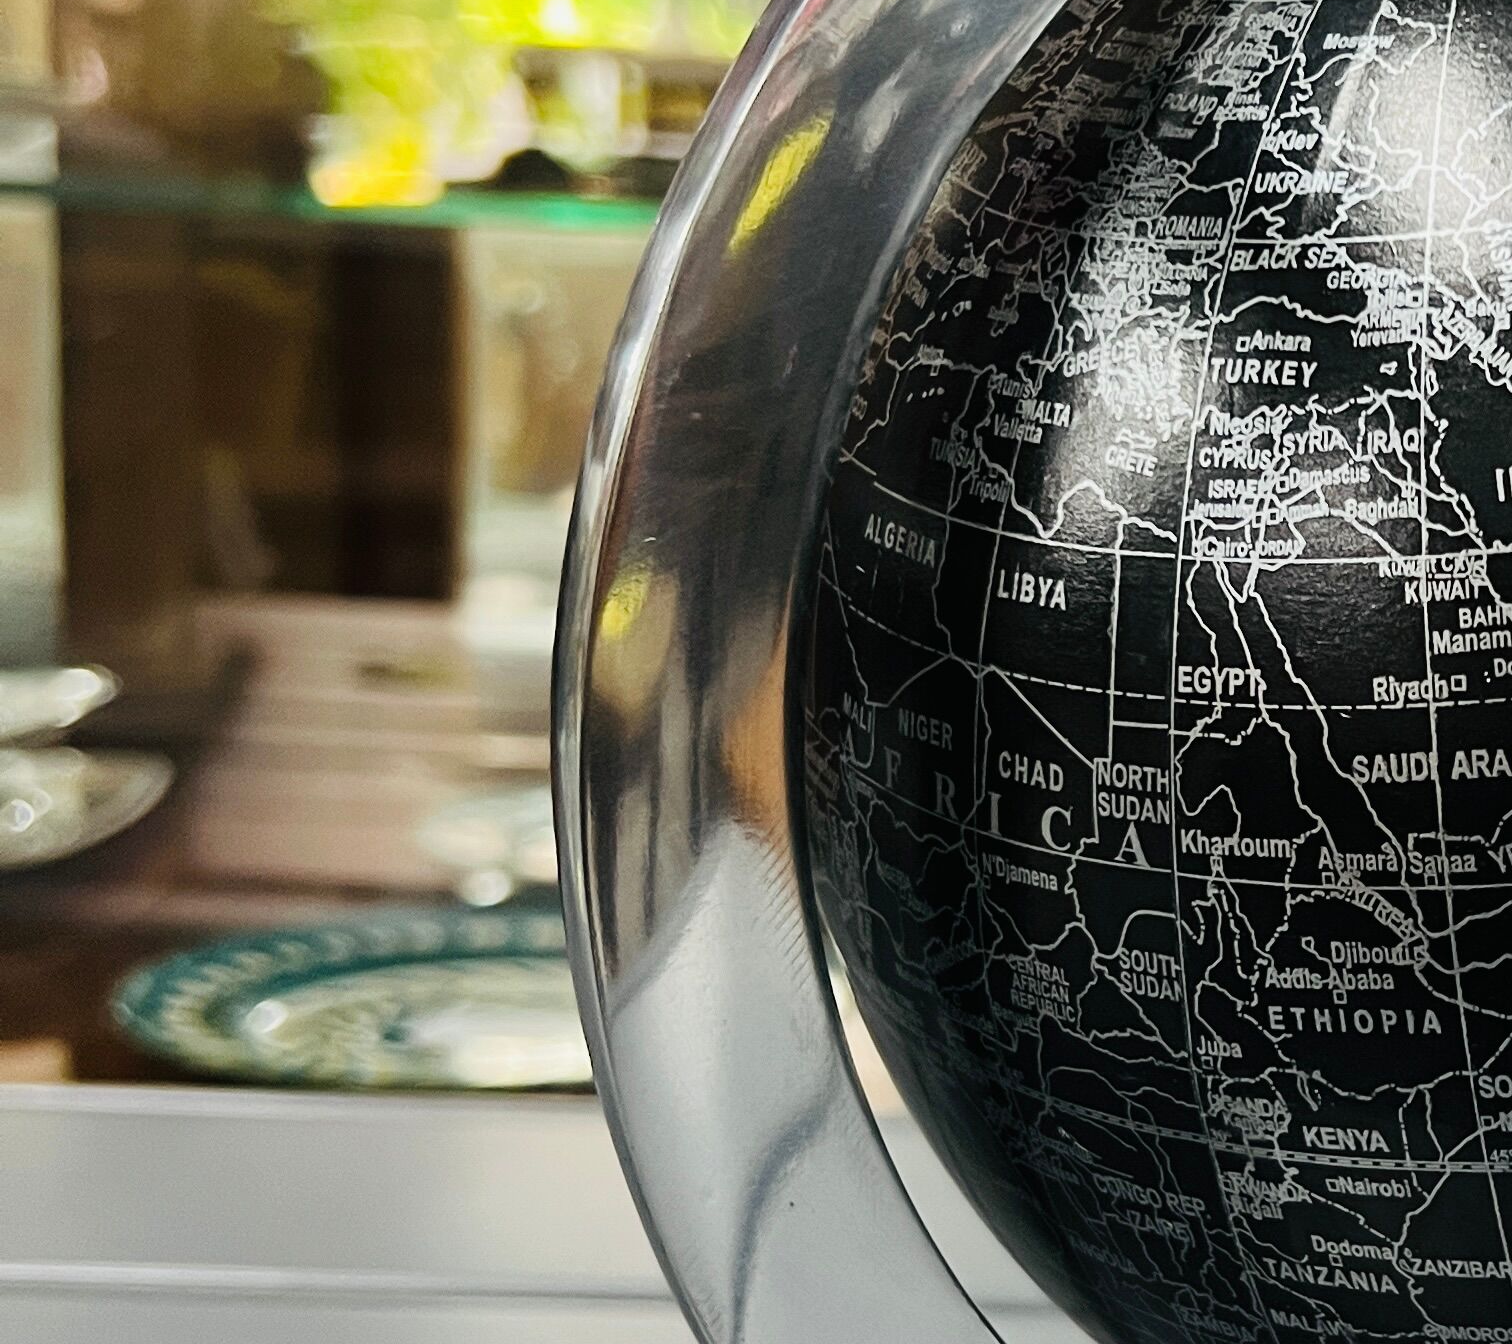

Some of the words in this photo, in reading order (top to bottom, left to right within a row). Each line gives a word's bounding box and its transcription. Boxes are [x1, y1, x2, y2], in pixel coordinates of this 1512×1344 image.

[1323, 33, 1396, 51] Moscow
[1255, 171, 1349, 194] UKRAINE
[1155, 215, 1223, 238] ROMANIA
[1230, 247, 1298, 272] BLACK
[1304, 245, 1348, 270] SEA
[1326, 263, 1408, 290] GEORGIA
[1249, 330, 1312, 353] Ankara
[1207, 356, 1318, 388] TURKEY
[1022, 399, 1072, 428] MALTA
[1209, 413, 1284, 437] Nicosia
[993, 413, 1043, 445] Valletta
[1283, 431, 1346, 455] SYRIA
[1366, 429, 1421, 455] IRAQ
[1105, 445, 1158, 478] CRETE
[1199, 446, 1272, 470] CYPRUS
[969, 474, 1010, 504] Tripoli
[1289, 465, 1371, 490] Damascus
[1345, 497, 1420, 526] Baghdad
[864, 513, 938, 569] ALGERIA
[1202, 536, 1248, 558] Cairo
[1378, 554, 1438, 578] Kuwait
[997, 568, 1067, 611] LIBYA
[1404, 577, 1483, 605] KUWAIT
[1177, 665, 1263, 698] EGYPT
[1372, 674, 1449, 707] Riyadh
[898, 707, 954, 752] NIGER
[998, 750, 1065, 792] CHAD
[1098, 761, 1171, 796] NORTH
[1353, 750, 1438, 784] SAUDI
[1097, 791, 1171, 826] SUDAN
[1180, 828, 1293, 860] Khartoum
[981, 852, 1059, 892] N'Djamena
[1317, 845, 1399, 874] Asmara
[1409, 851, 1479, 875] Sanaa
[1006, 957, 1071, 987] CENTRAL
[1118, 946, 1182, 979] SOUTH
[1011, 974, 1071, 1004] AFRICAN
[1120, 970, 1183, 1003] SUDAN
[1264, 967, 1323, 990] Addis
[1328, 967, 1395, 991] Ababa
[1010, 988, 1077, 1024] REPUBLIC
[1268, 1004, 1442, 1035] ETHIOPIA
[1196, 1034, 1243, 1059] Juba
[1302, 1125, 1391, 1154] KENYA
[1092, 1172, 1162, 1210] CONGO
[1337, 1175, 1412, 1199] Nairobi
[1310, 1234, 1393, 1261] Dodoma
[1262, 1257, 1400, 1295] TANZANIA
